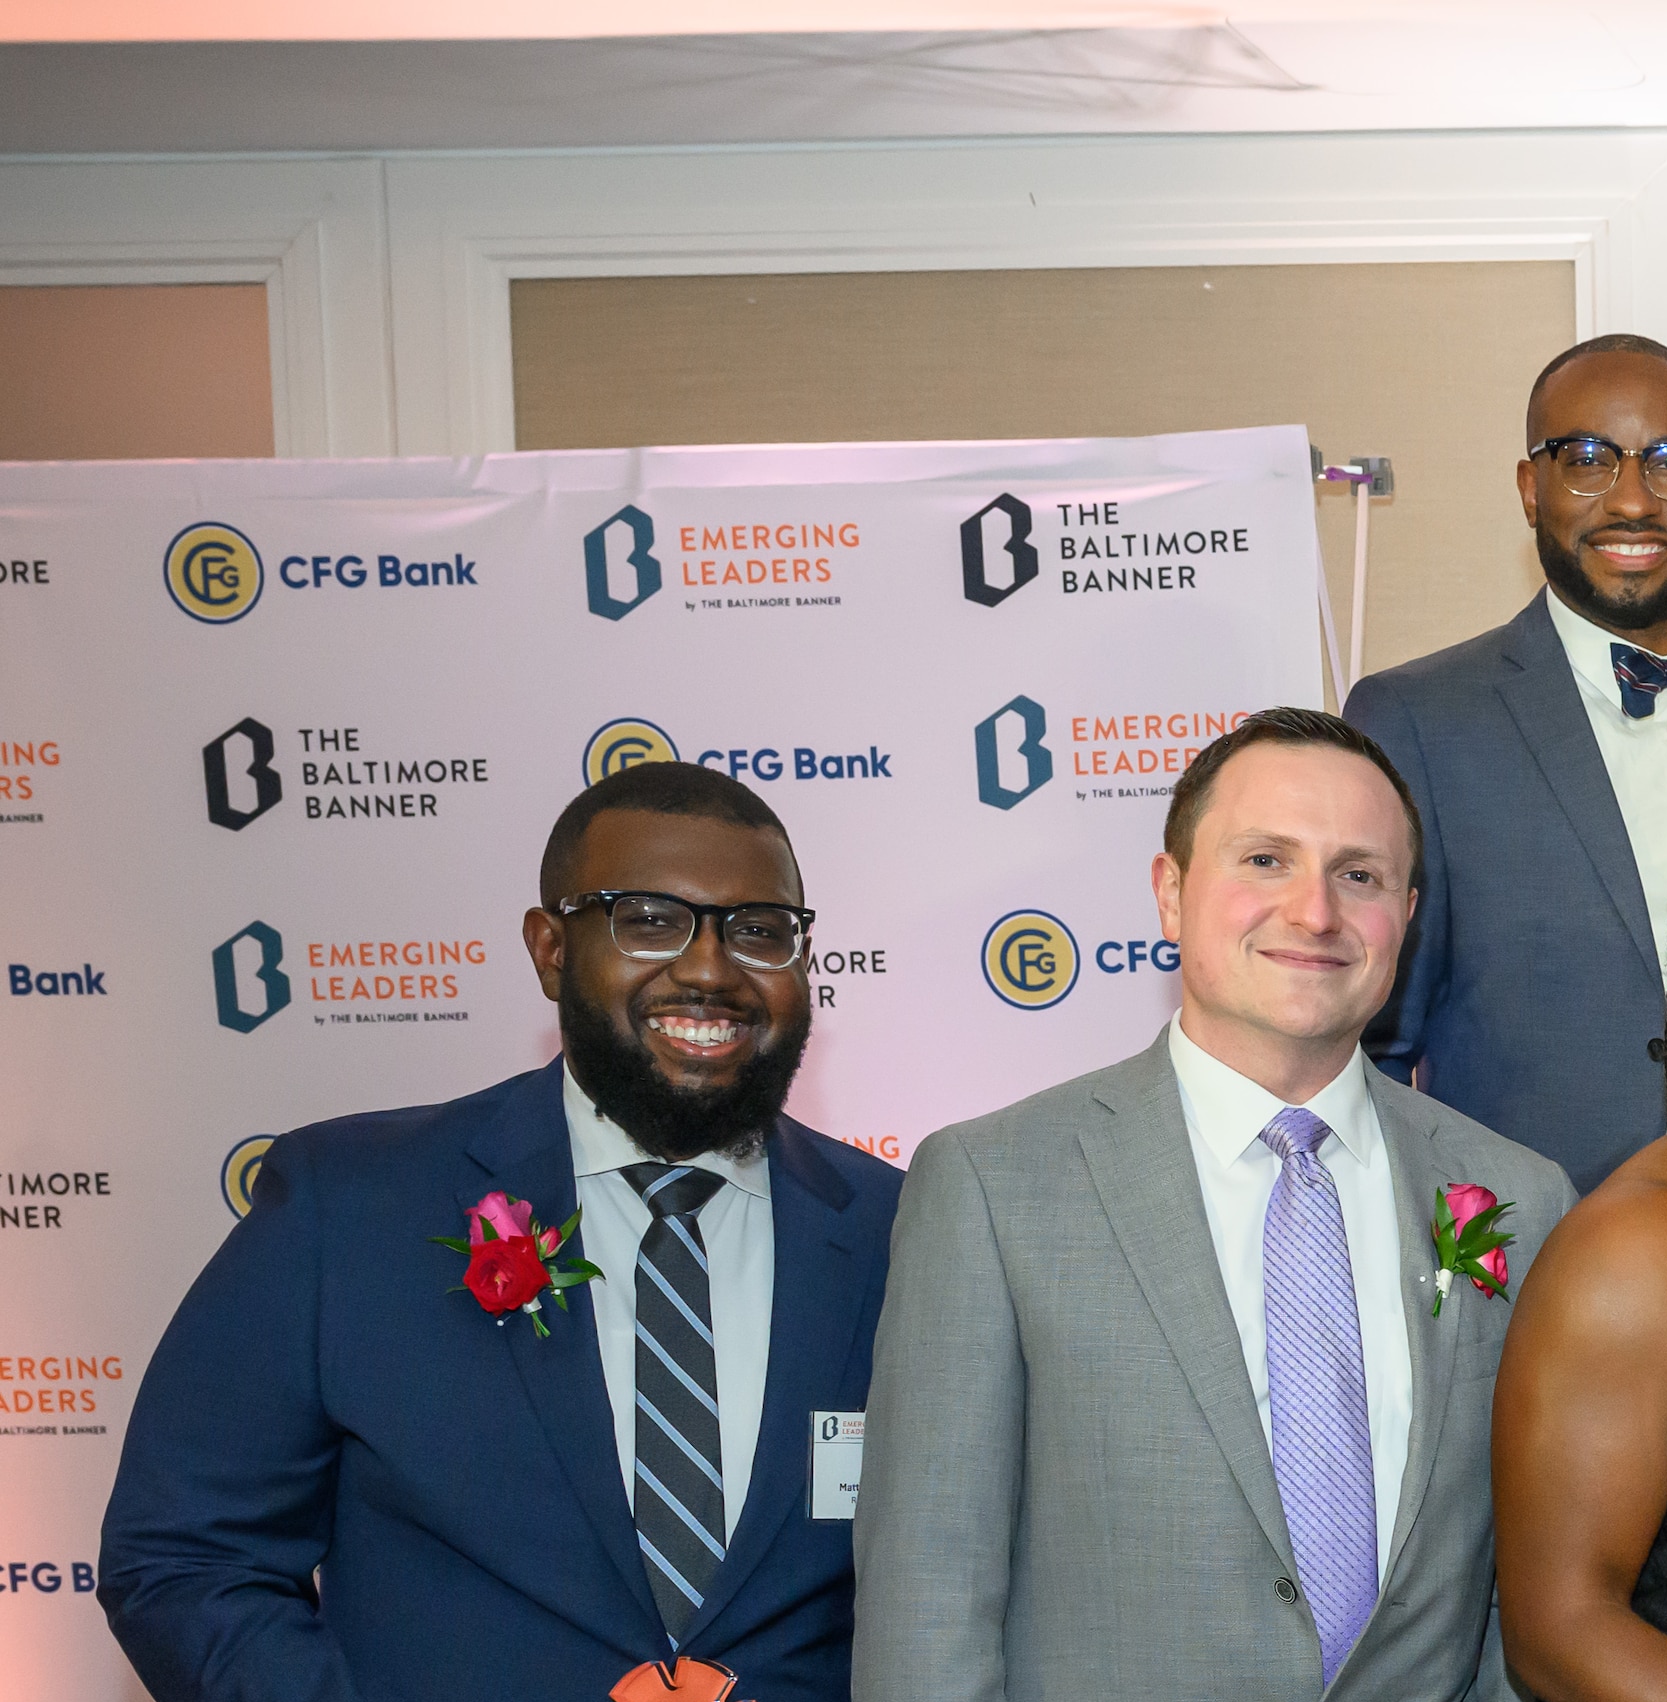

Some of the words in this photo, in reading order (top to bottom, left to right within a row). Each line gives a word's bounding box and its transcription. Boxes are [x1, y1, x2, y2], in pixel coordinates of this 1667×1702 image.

[1057, 503, 1118, 526] THE
[681, 524, 859, 551] EMERGING
[1060, 528, 1249, 560] BALTIMORE
[280, 556, 367, 589] CFG
[378, 554, 477, 586] Bank
[683, 558, 831, 585] LEADERS
[1063, 566, 1195, 593] BANNER
[702, 600, 721, 608] THE
[728, 598, 789, 607] BALTIMORE
[796, 597, 840, 605] BANNER
[299, 729, 359, 751] THE
[303, 759, 487, 785] BALTIMORE
[794, 746, 891, 779] Bank
[306, 794, 436, 818] BANNER
[1076, 792, 1086, 800] by
[1093, 789, 1112, 797] THE
[1119, 787, 1173, 797] BALTIMO
[309, 941, 485, 967] EMERGING
[1096, 940, 1181, 973] CFG
[9, 964, 106, 995] Bank
[312, 975, 457, 1000] LEADERS
[315, 1016, 324, 1025] by
[331, 1014, 350, 1023] THE
[356, 1013, 417, 1022] BALTIMORE
[424, 1012, 468, 1021] BANNER
[840, 1483, 860, 1492] Matt
